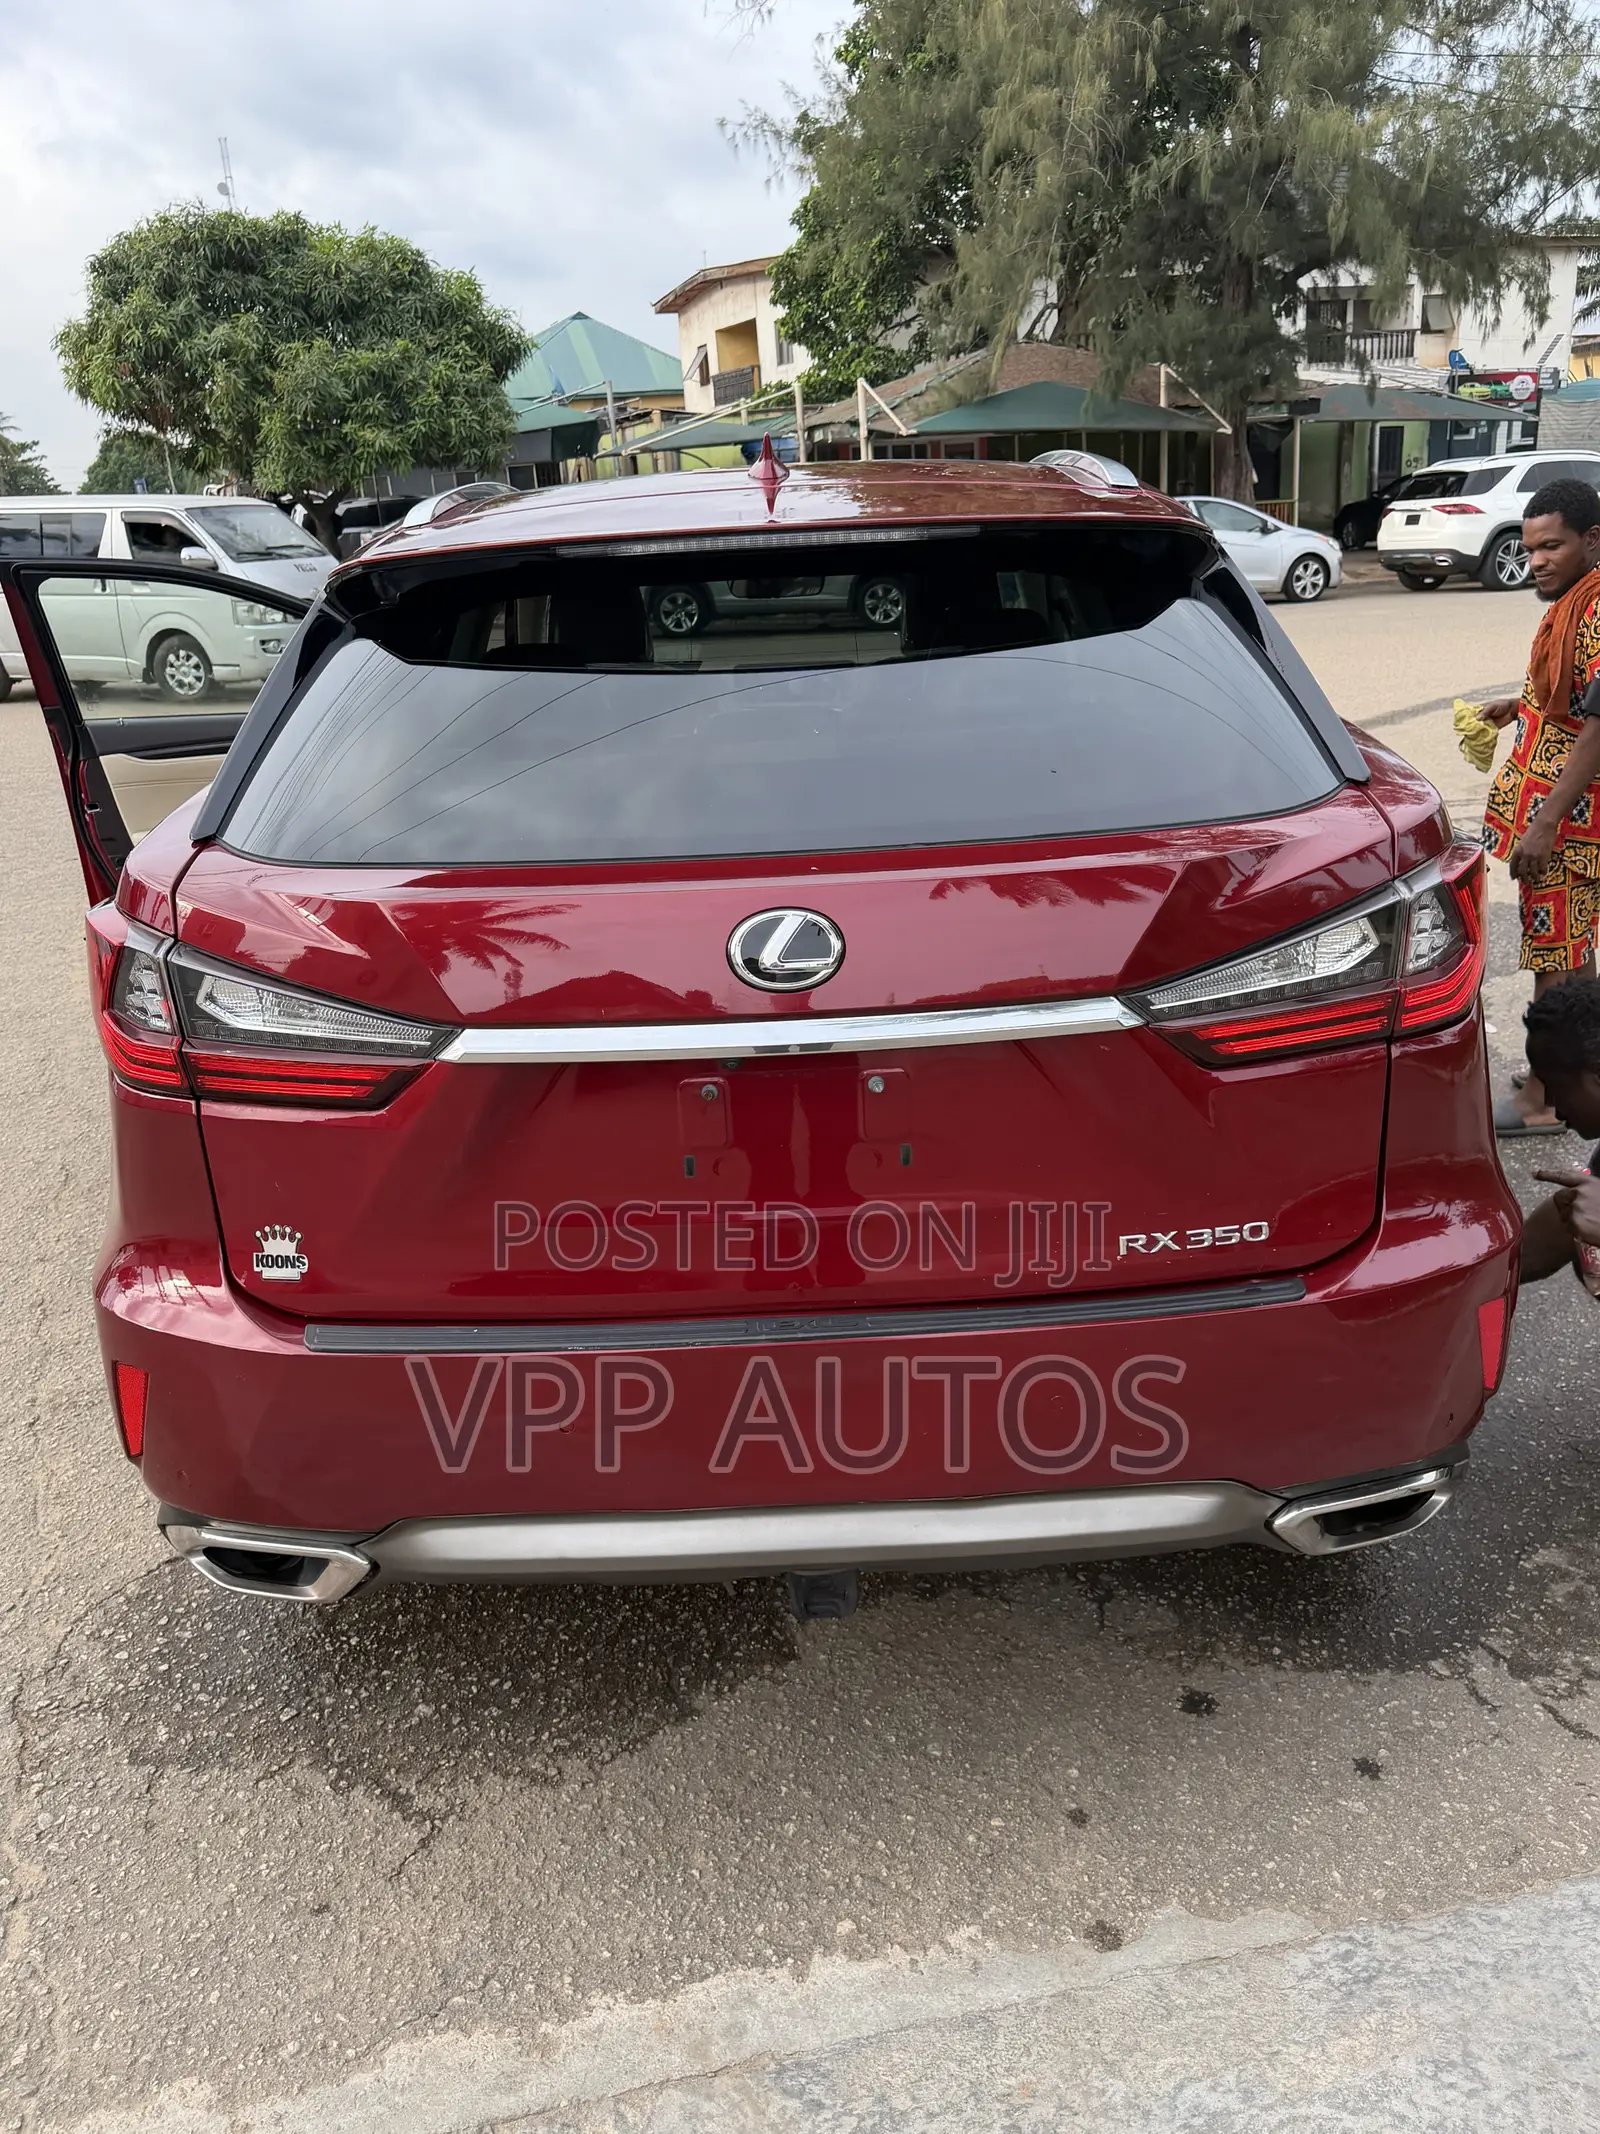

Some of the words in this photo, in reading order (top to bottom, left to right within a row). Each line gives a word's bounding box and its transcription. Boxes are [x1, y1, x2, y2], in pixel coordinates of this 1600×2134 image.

[1119, 1230, 1182, 1256] RX
[1185, 1221, 1269, 1249] 350
[254, 1254, 307, 1270] KOONS
